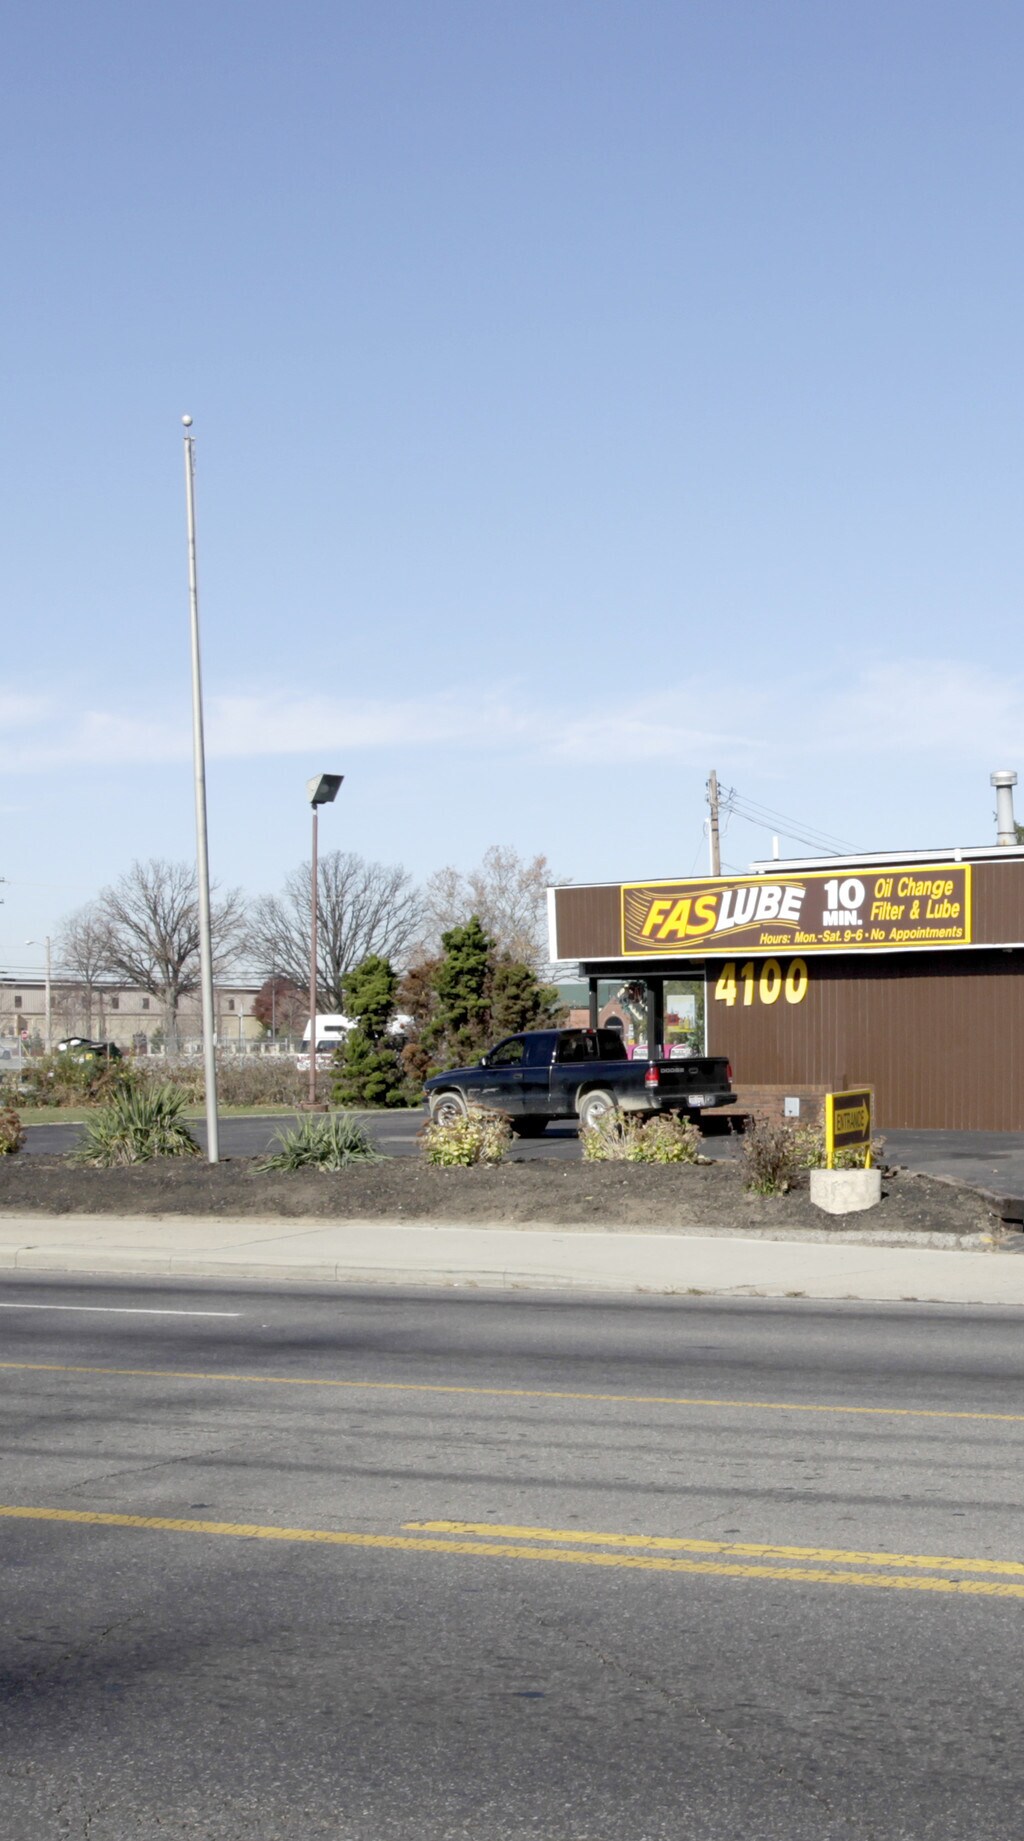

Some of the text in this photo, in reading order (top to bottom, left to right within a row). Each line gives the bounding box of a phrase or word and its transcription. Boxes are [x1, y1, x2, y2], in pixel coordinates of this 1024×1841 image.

[824, 878, 866, 910] 10
[874, 877, 954, 900] Oil Change
[641, 886, 806, 939] FASLUBE
[822, 910, 863, 926] MIN.
[870, 899, 960, 921] Filter & Lube
[759, 932, 791, 944] Hours:
[844, 928, 863, 942] 9-6
[870, 928, 885, 940] No
[889, 926, 963, 942] Appointments
[715, 958, 808, 1006] 4100
[836, 1109, 865, 1132] ENTRANCE
